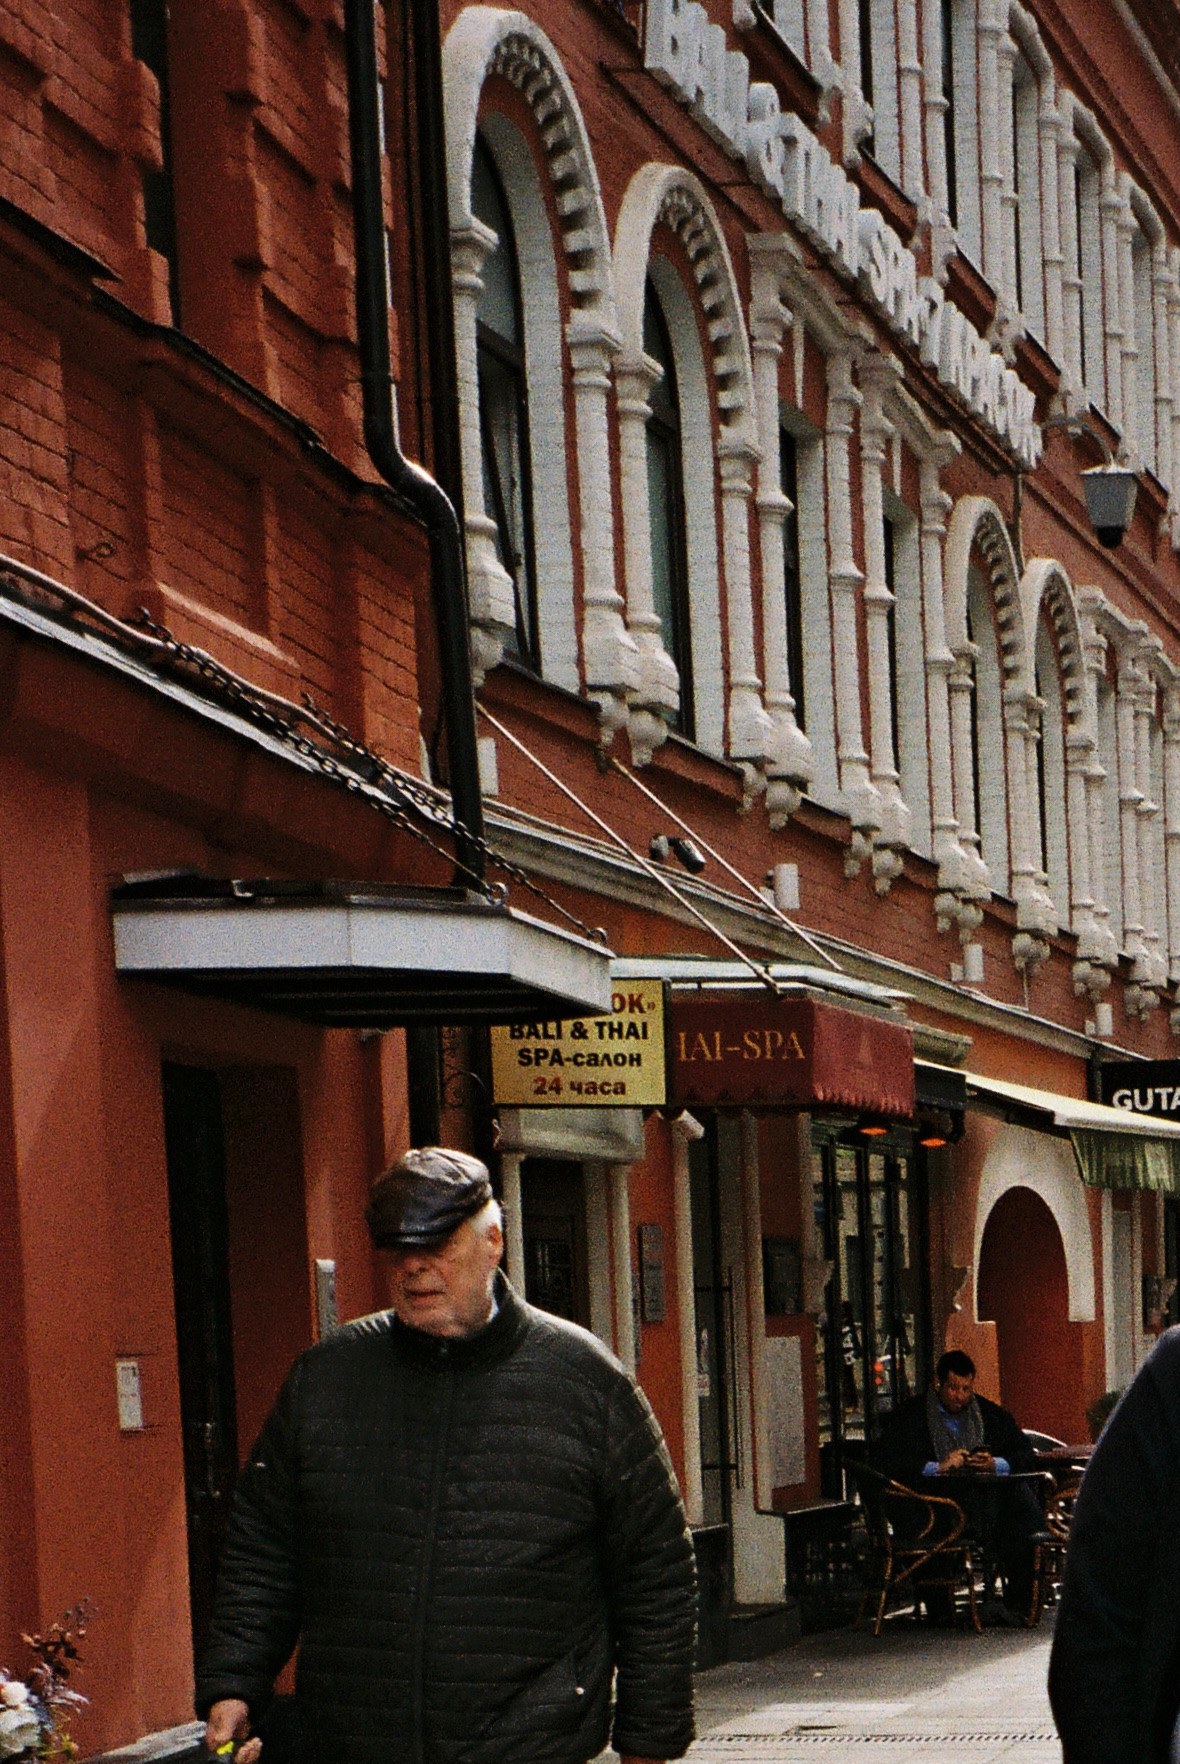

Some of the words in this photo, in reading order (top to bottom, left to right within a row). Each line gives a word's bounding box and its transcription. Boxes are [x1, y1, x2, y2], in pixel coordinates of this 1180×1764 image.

[860, 209, 917, 344] SPA
[509, 1021, 562, 1040] BALI
[570, 1021, 589, 1040] &
[595, 1021, 648, 1040] THAI
[518, 1048, 642, 1067] SPA-салон
[533, 1076, 563, 1096] 24
[570, 1080, 626, 1096] часа
